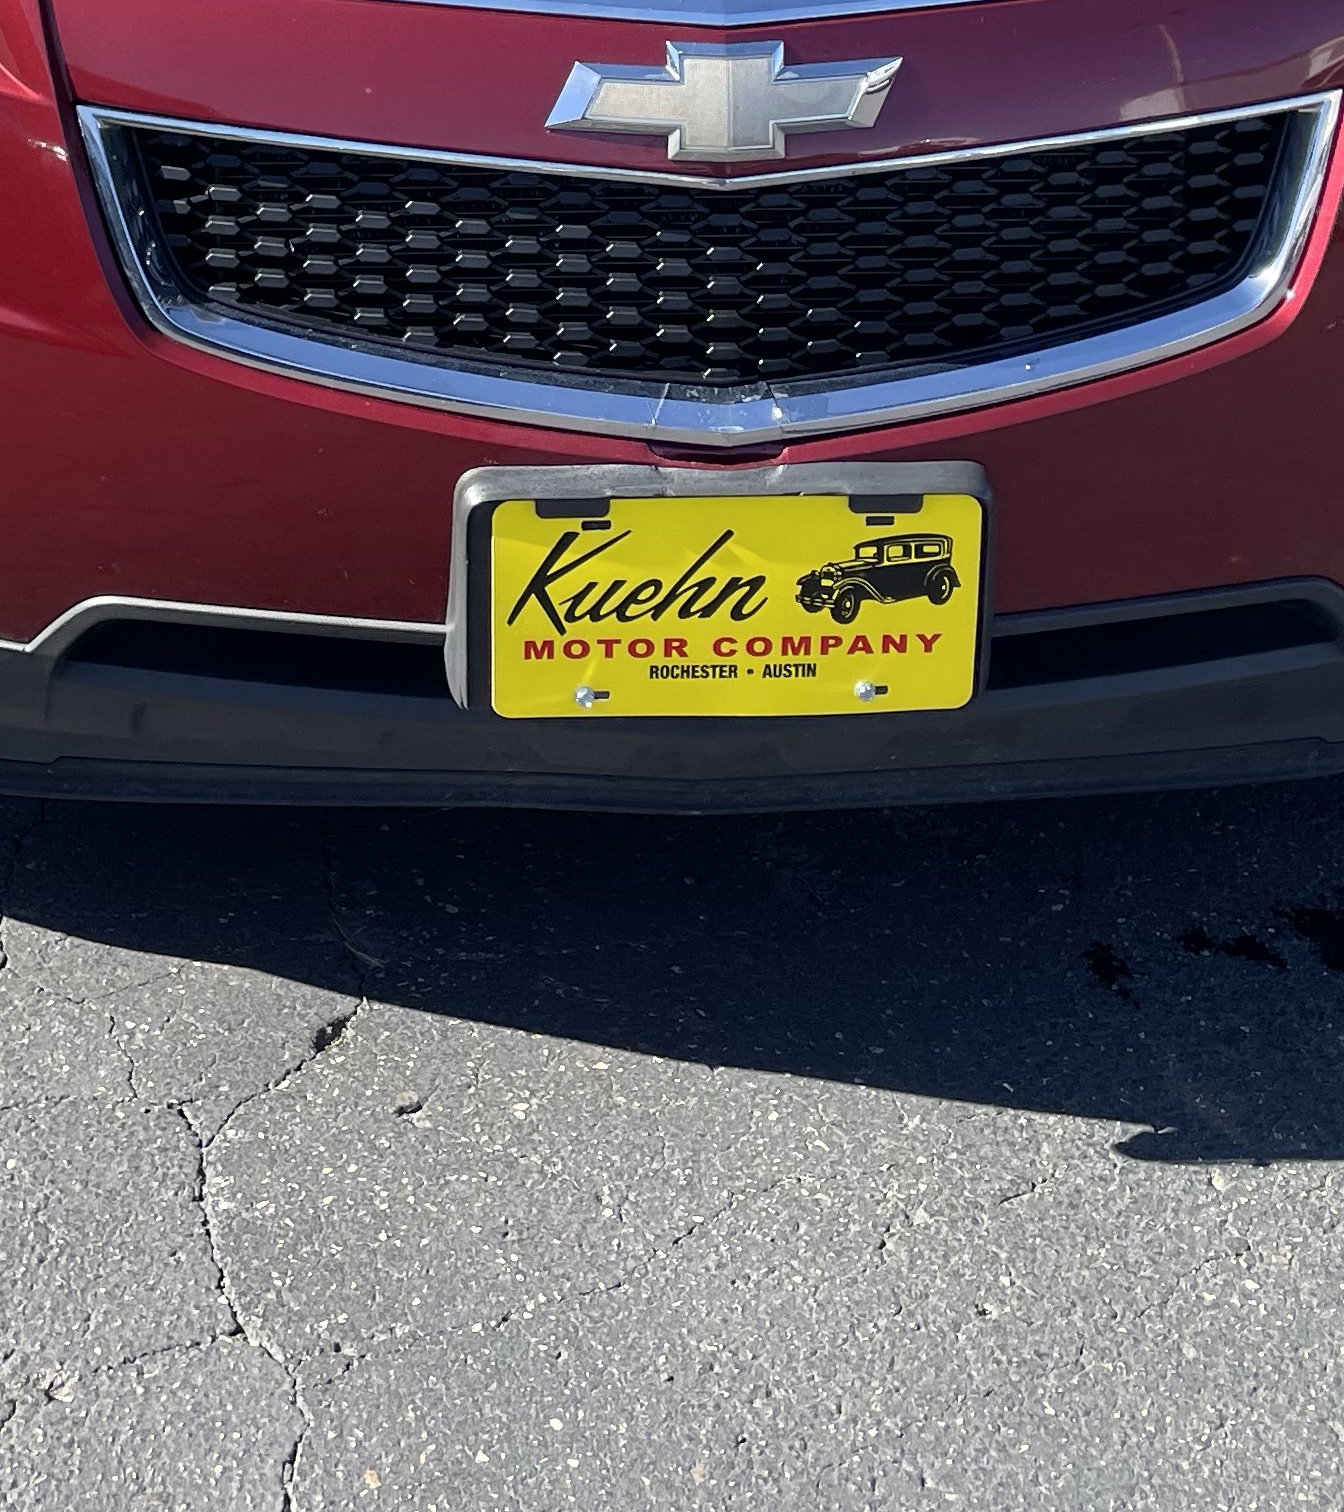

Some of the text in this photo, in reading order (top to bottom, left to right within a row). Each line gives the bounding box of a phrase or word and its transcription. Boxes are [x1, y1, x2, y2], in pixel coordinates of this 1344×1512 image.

[506, 528, 770, 636] Kuehn
[522, 632, 943, 661] MOTOR COMPANY
[648, 662, 817, 680] ROCHESTER AUSTIN
